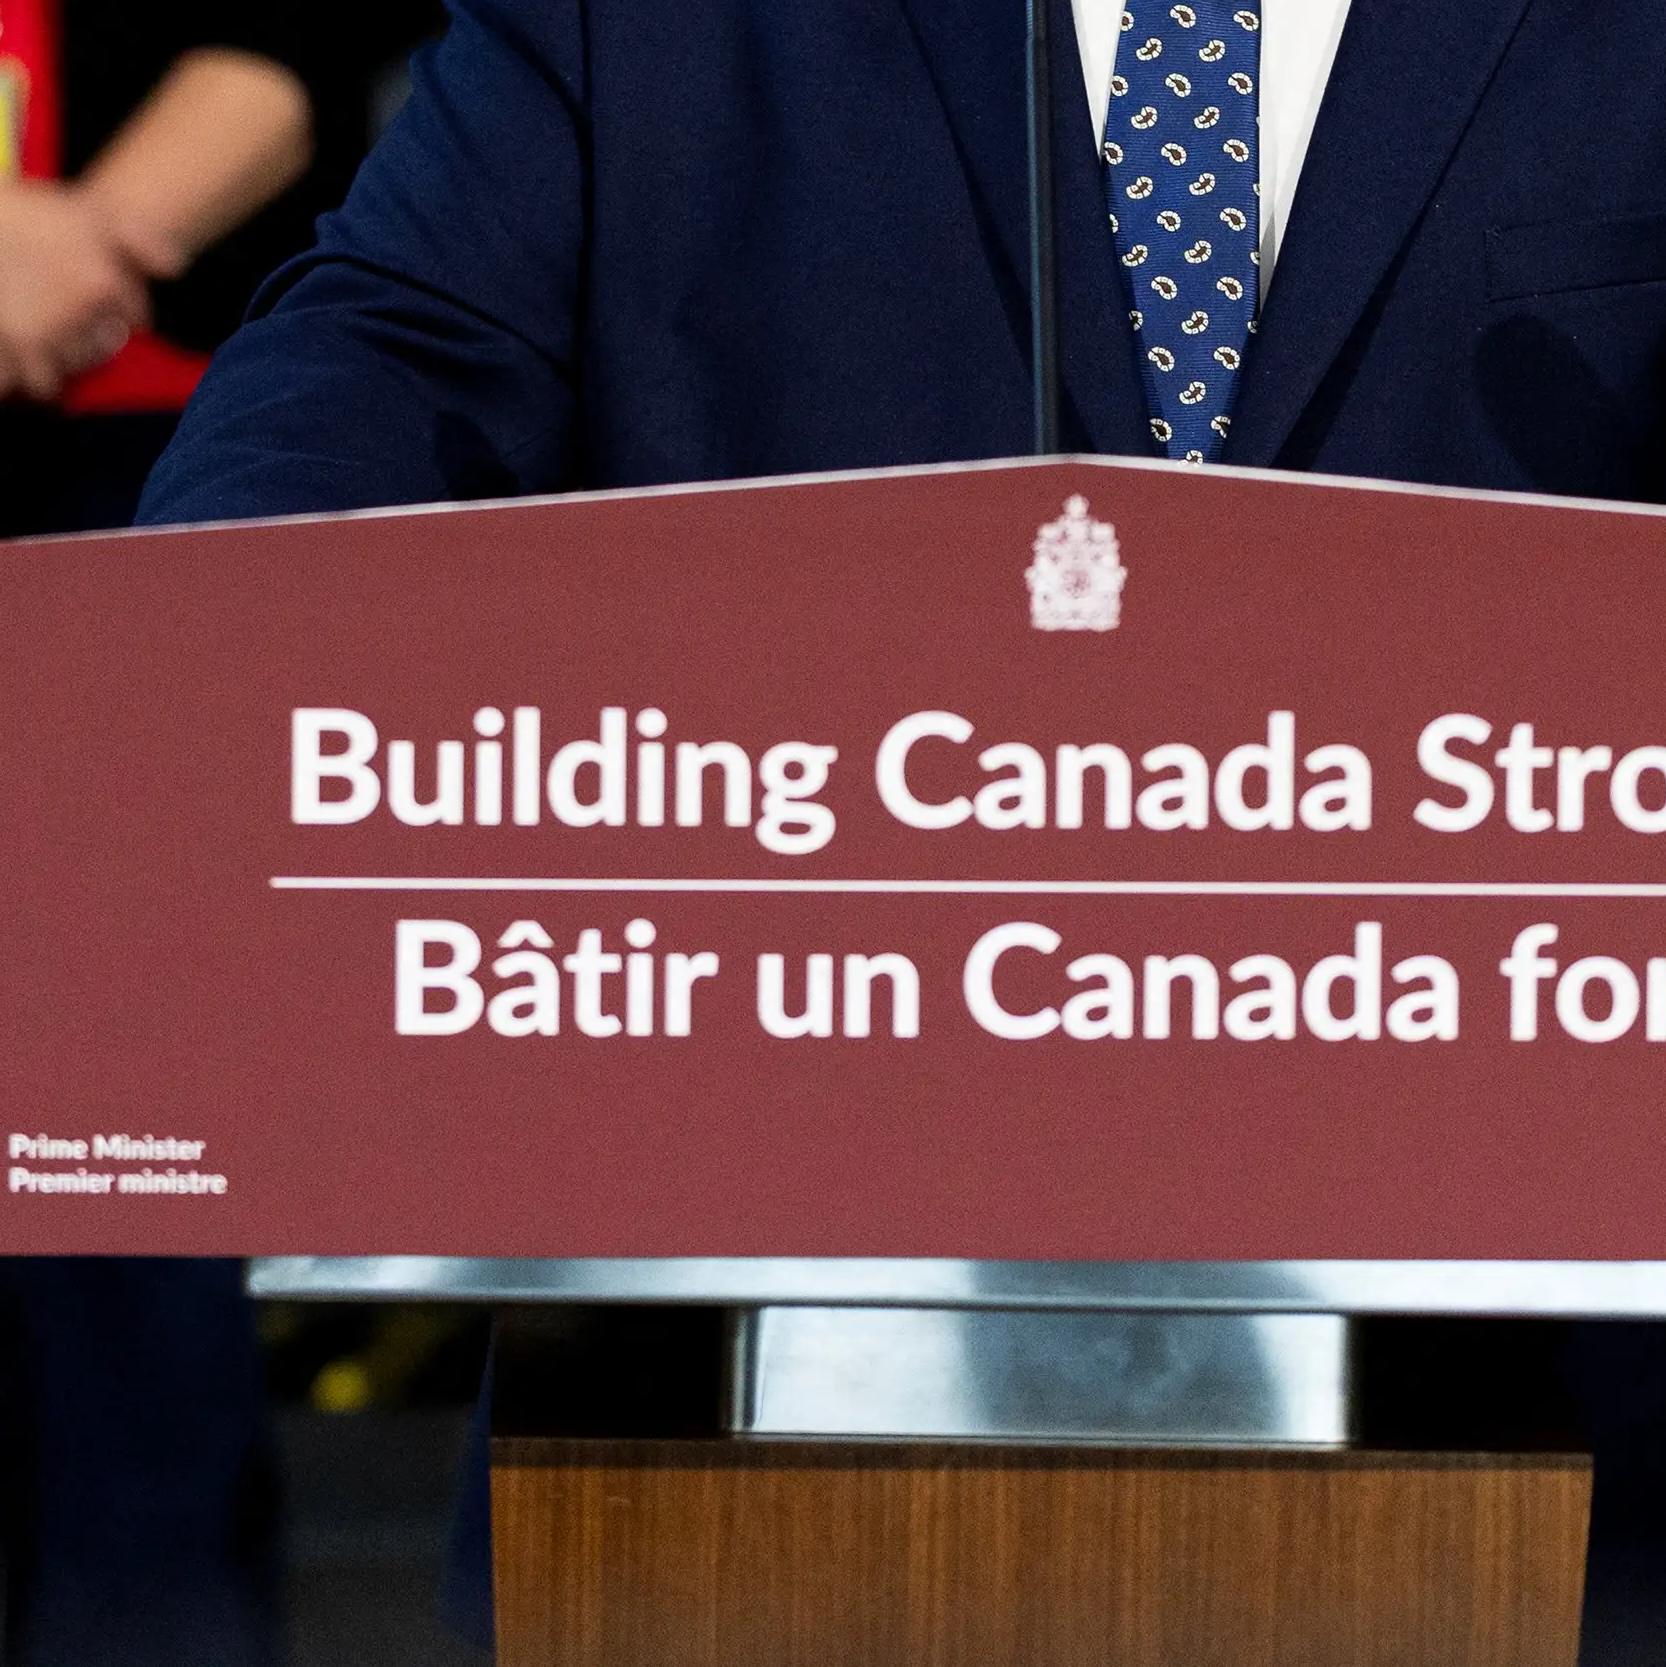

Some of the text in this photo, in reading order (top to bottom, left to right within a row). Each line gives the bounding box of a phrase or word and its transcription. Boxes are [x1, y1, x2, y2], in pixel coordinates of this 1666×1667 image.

[291, 706, 839, 856] Building
[875, 709, 1373, 832] Canada
[394, 918, 720, 1038] Bâtir
[757, 952, 920, 1039] un
[963, 921, 1460, 1043] Canada
[8, 1133, 206, 1161] Prime Minister
[8, 1166, 229, 1195] Premier ministre
